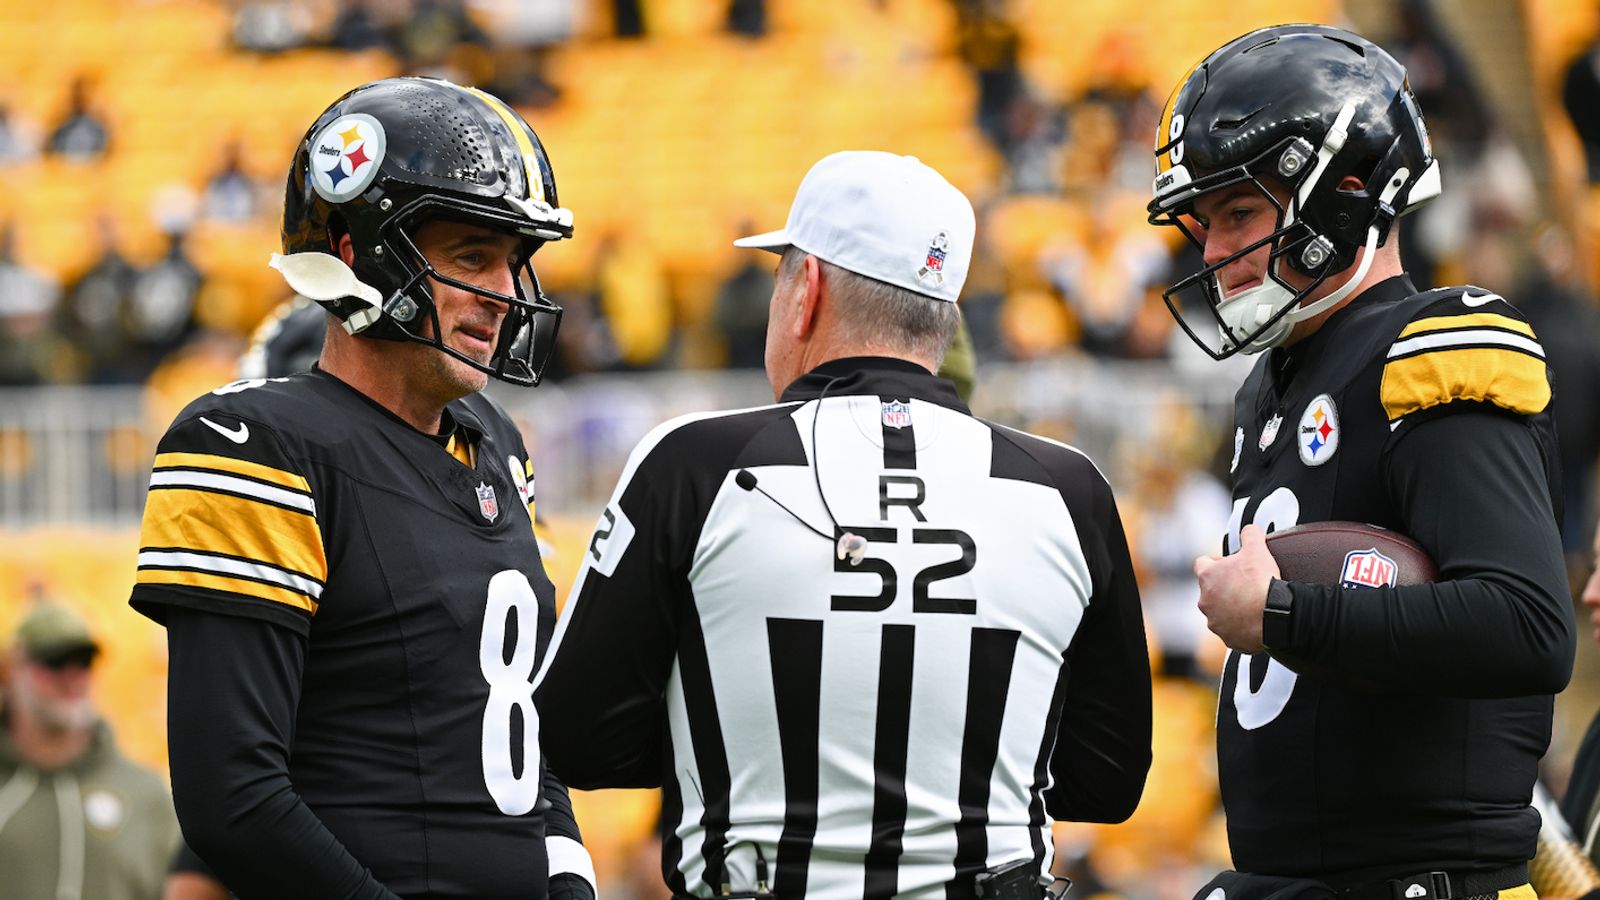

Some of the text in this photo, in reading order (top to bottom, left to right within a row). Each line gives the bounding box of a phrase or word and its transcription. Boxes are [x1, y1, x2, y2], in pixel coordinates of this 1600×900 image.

[319, 145, 341, 156] Steelers
[525, 153, 545, 201] 8
[879, 475, 928, 522] R
[831, 525, 977, 615] 52
[1351, 556, 1391, 585] NFL
[480, 569, 541, 816] 8
